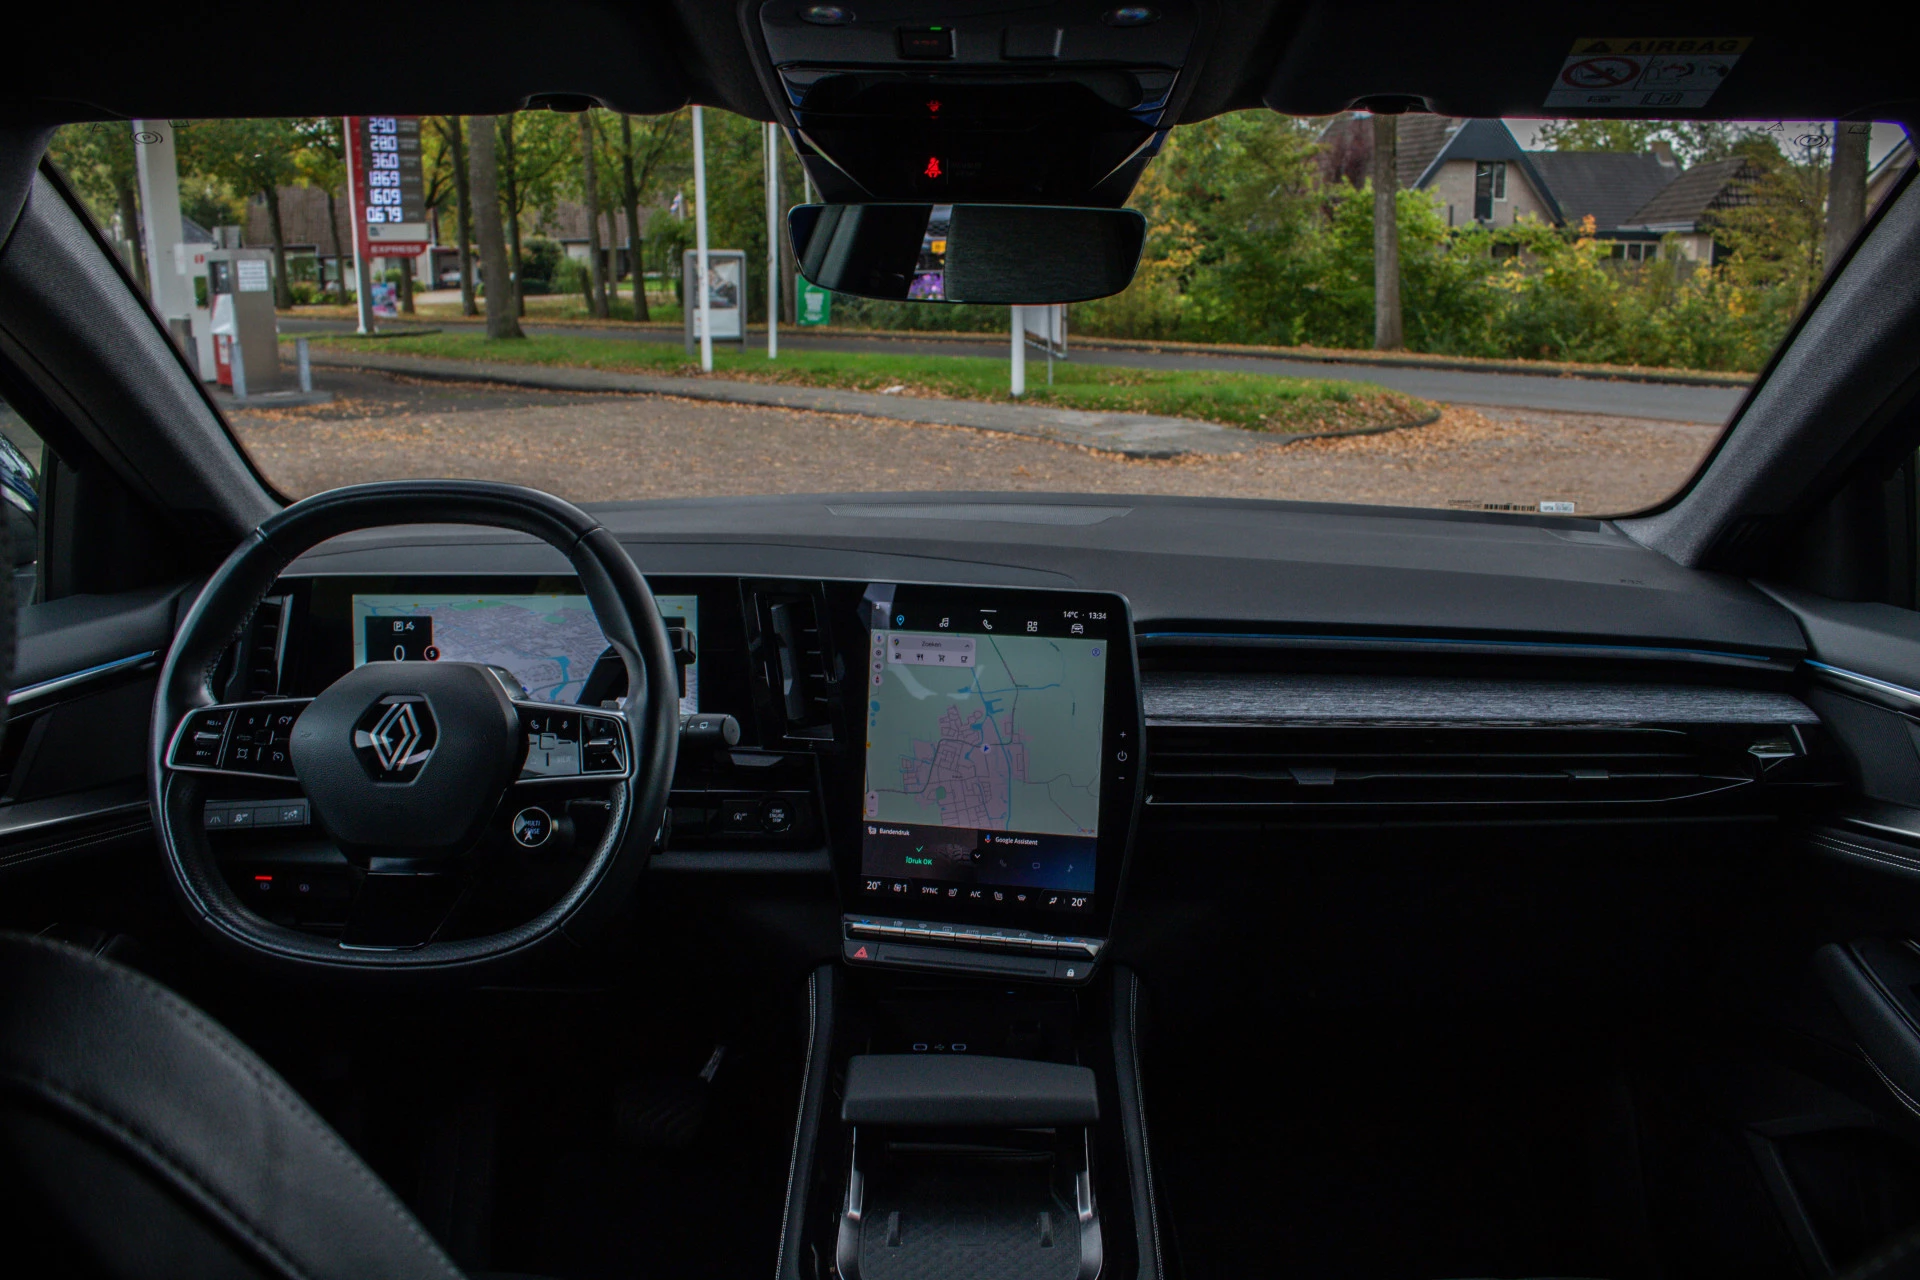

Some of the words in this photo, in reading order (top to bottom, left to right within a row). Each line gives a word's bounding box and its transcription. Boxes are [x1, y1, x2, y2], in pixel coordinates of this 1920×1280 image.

[1624, 40, 1738, 53] AIRBAG
[1088, 612, 1107, 620] 13:34
[921, 639, 942, 648] Zoeken
[879, 827, 911, 837] Bandendruk
[995, 836, 1013, 846] Google
[1014, 838, 1039, 846] Assistent
[922, 858, 933, 866] OK
[921, 886, 939, 895] SYNC
[970, 890, 981, 898] A/C
